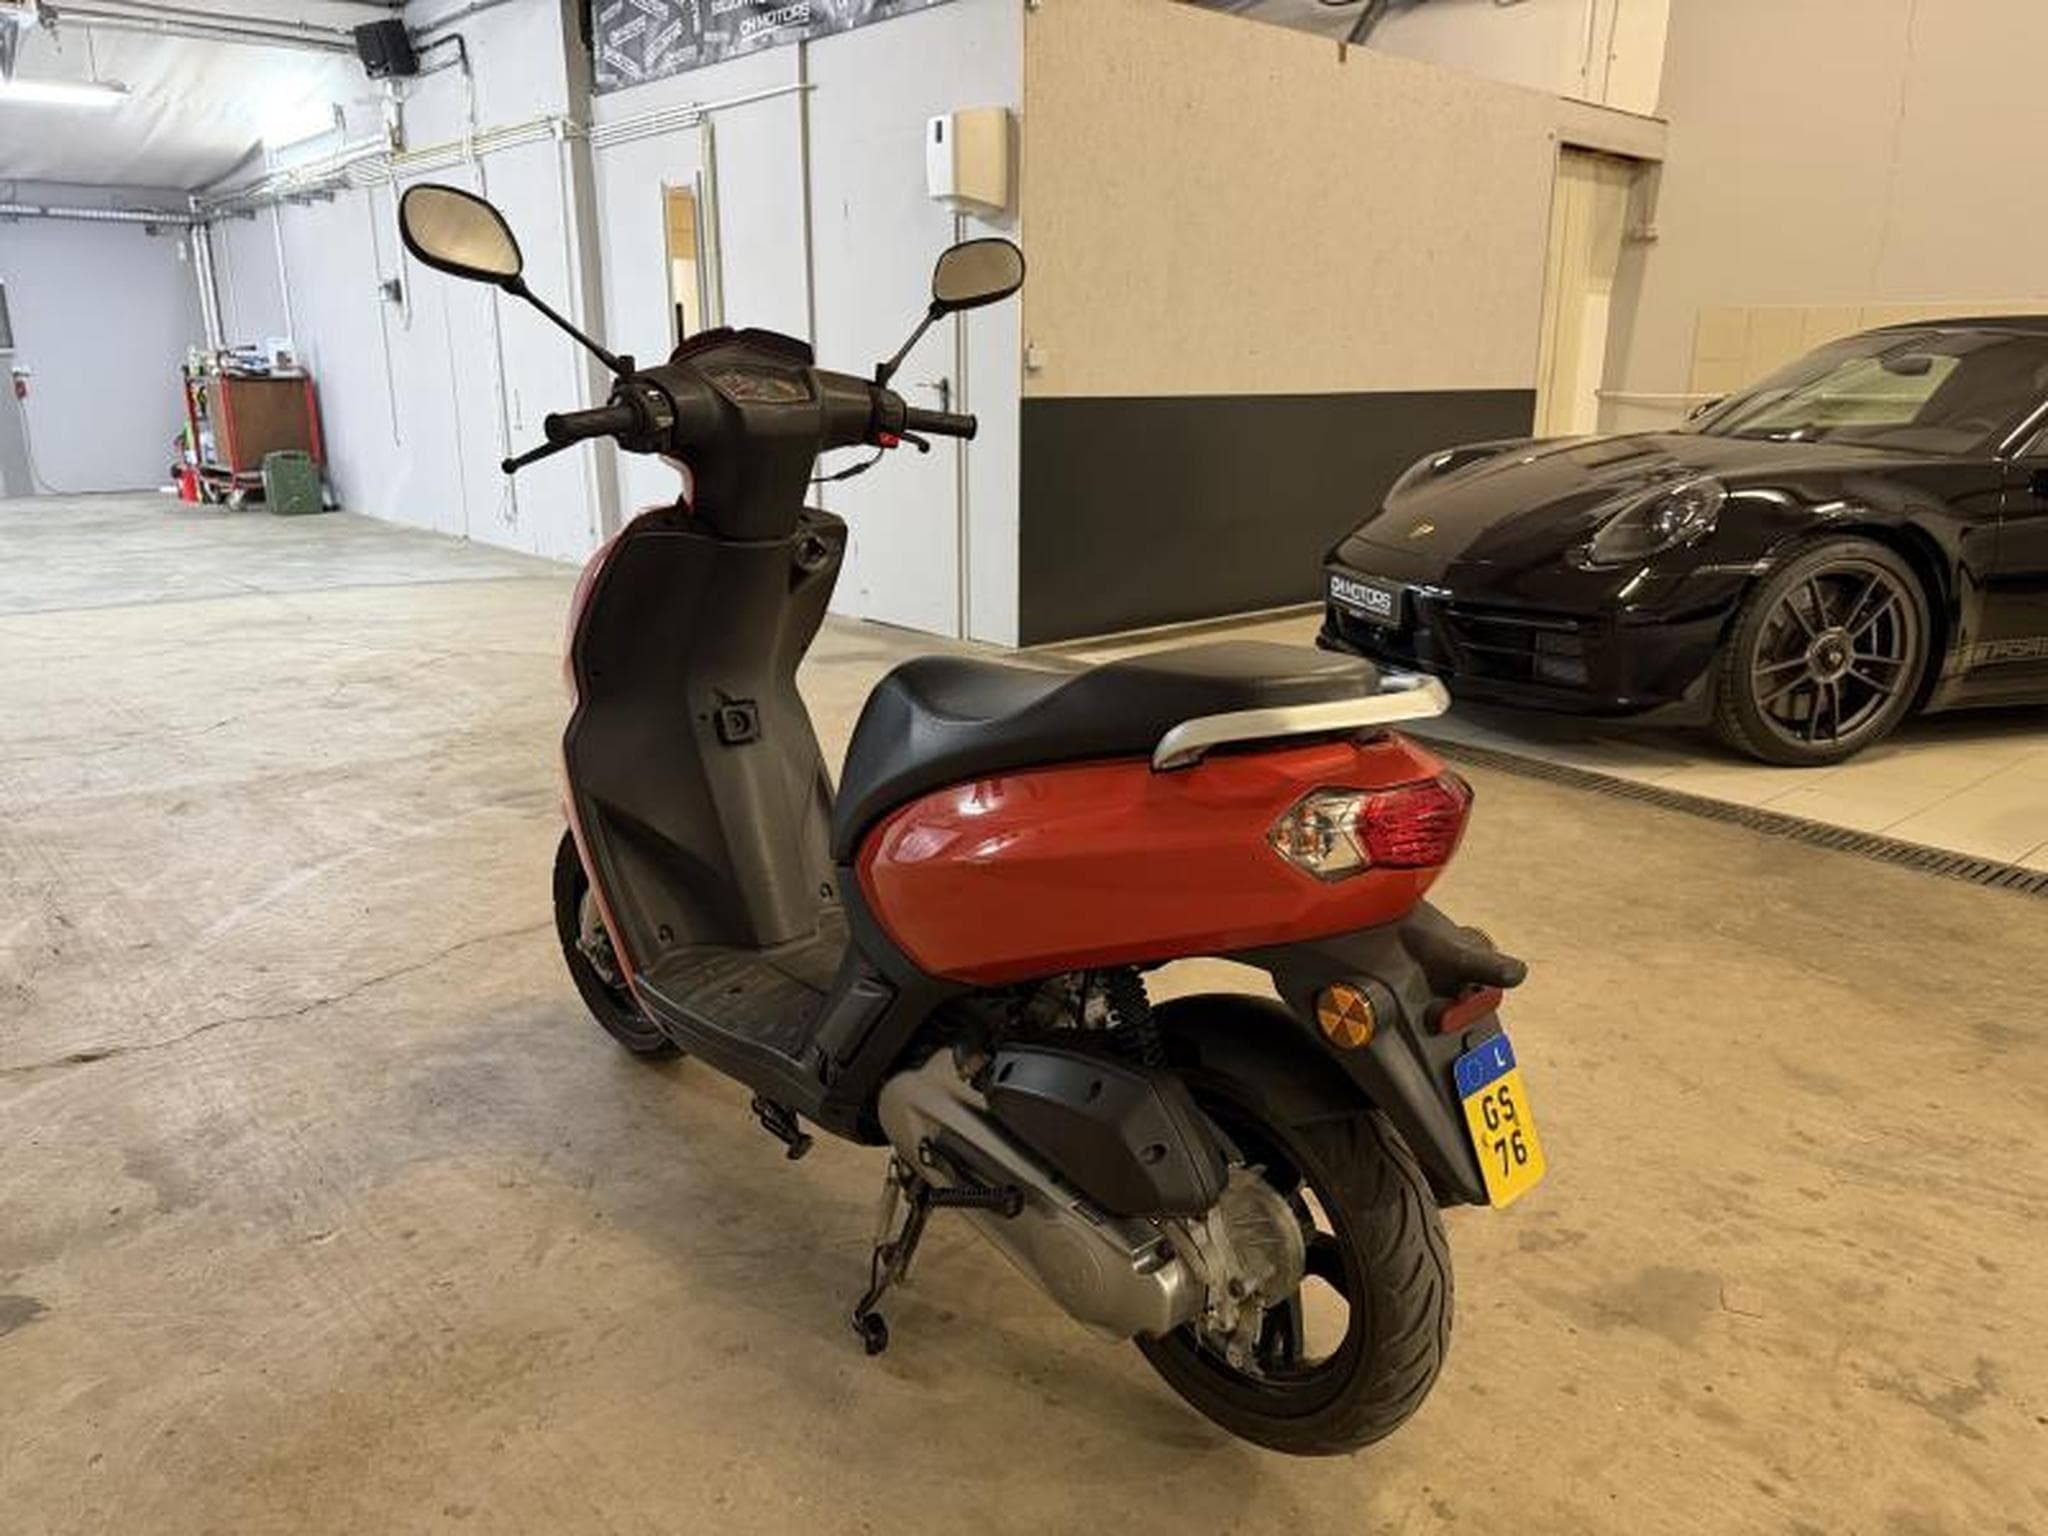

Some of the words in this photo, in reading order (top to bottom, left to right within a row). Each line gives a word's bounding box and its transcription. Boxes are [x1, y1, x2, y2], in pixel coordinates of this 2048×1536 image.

[1493, 1047, 1506, 1067] L
[1481, 1085, 1515, 1131] GS
[1494, 1129, 1528, 1177] 76
